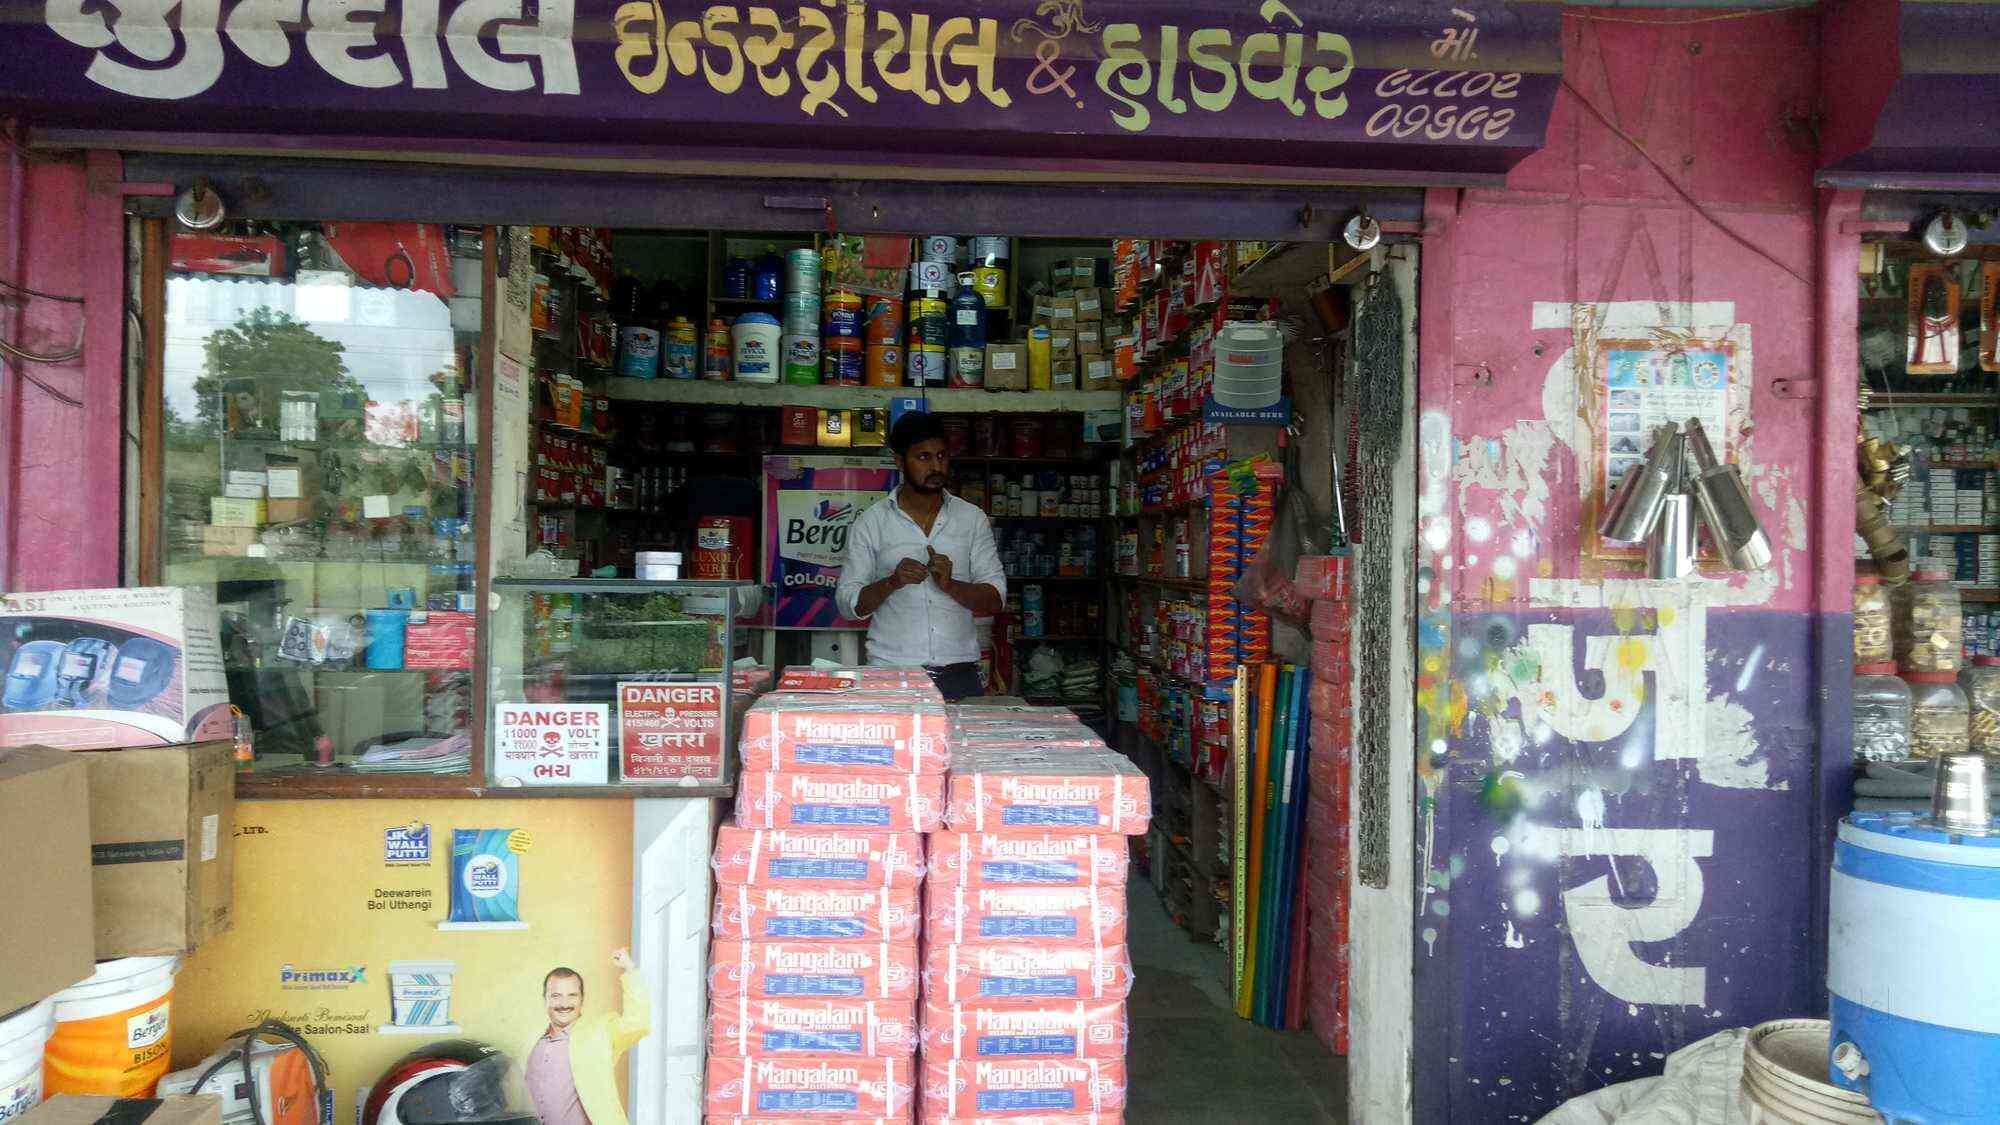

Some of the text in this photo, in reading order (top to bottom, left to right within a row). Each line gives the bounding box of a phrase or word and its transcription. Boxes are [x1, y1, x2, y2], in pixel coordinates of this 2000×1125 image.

[1210, 410, 1256, 418] AVAILABLE
[787, 518, 850, 553] Berg
[784, 573, 841, 588] COLOR
[625, 687, 715, 703] DANGER
[503, 711, 600, 726] DANGER
[684, 719, 714, 728] VOLTS
[504, 729, 601, 738] 11000 VOLT
[795, 717, 896, 743] Mangalam
[637, 733, 707, 751] खतरा
[533, 764, 572, 778] ભય
[792, 776, 893, 803] Mangalam
[1002, 778, 1099, 805] Mangalam
[387, 831, 409, 841] JK
[387, 841, 427, 850] WALL
[769, 831, 869, 858] Mangalam
[981, 834, 1080, 860] Mangalam
[387, 850, 427, 859] PUTTY
[375, 888, 432, 898] Deewarein
[367, 900, 433, 911] Bol Uthengi
[767, 889, 865, 915] Mangalam
[765, 947, 863, 975] Mangalam
[763, 1002, 864, 1029] Mangalam
[305, 1024, 370, 1035] Saalon-Saal
[757, 1063, 858, 1090] Mangalam
[976, 1063, 1079, 1090] Mangalam
